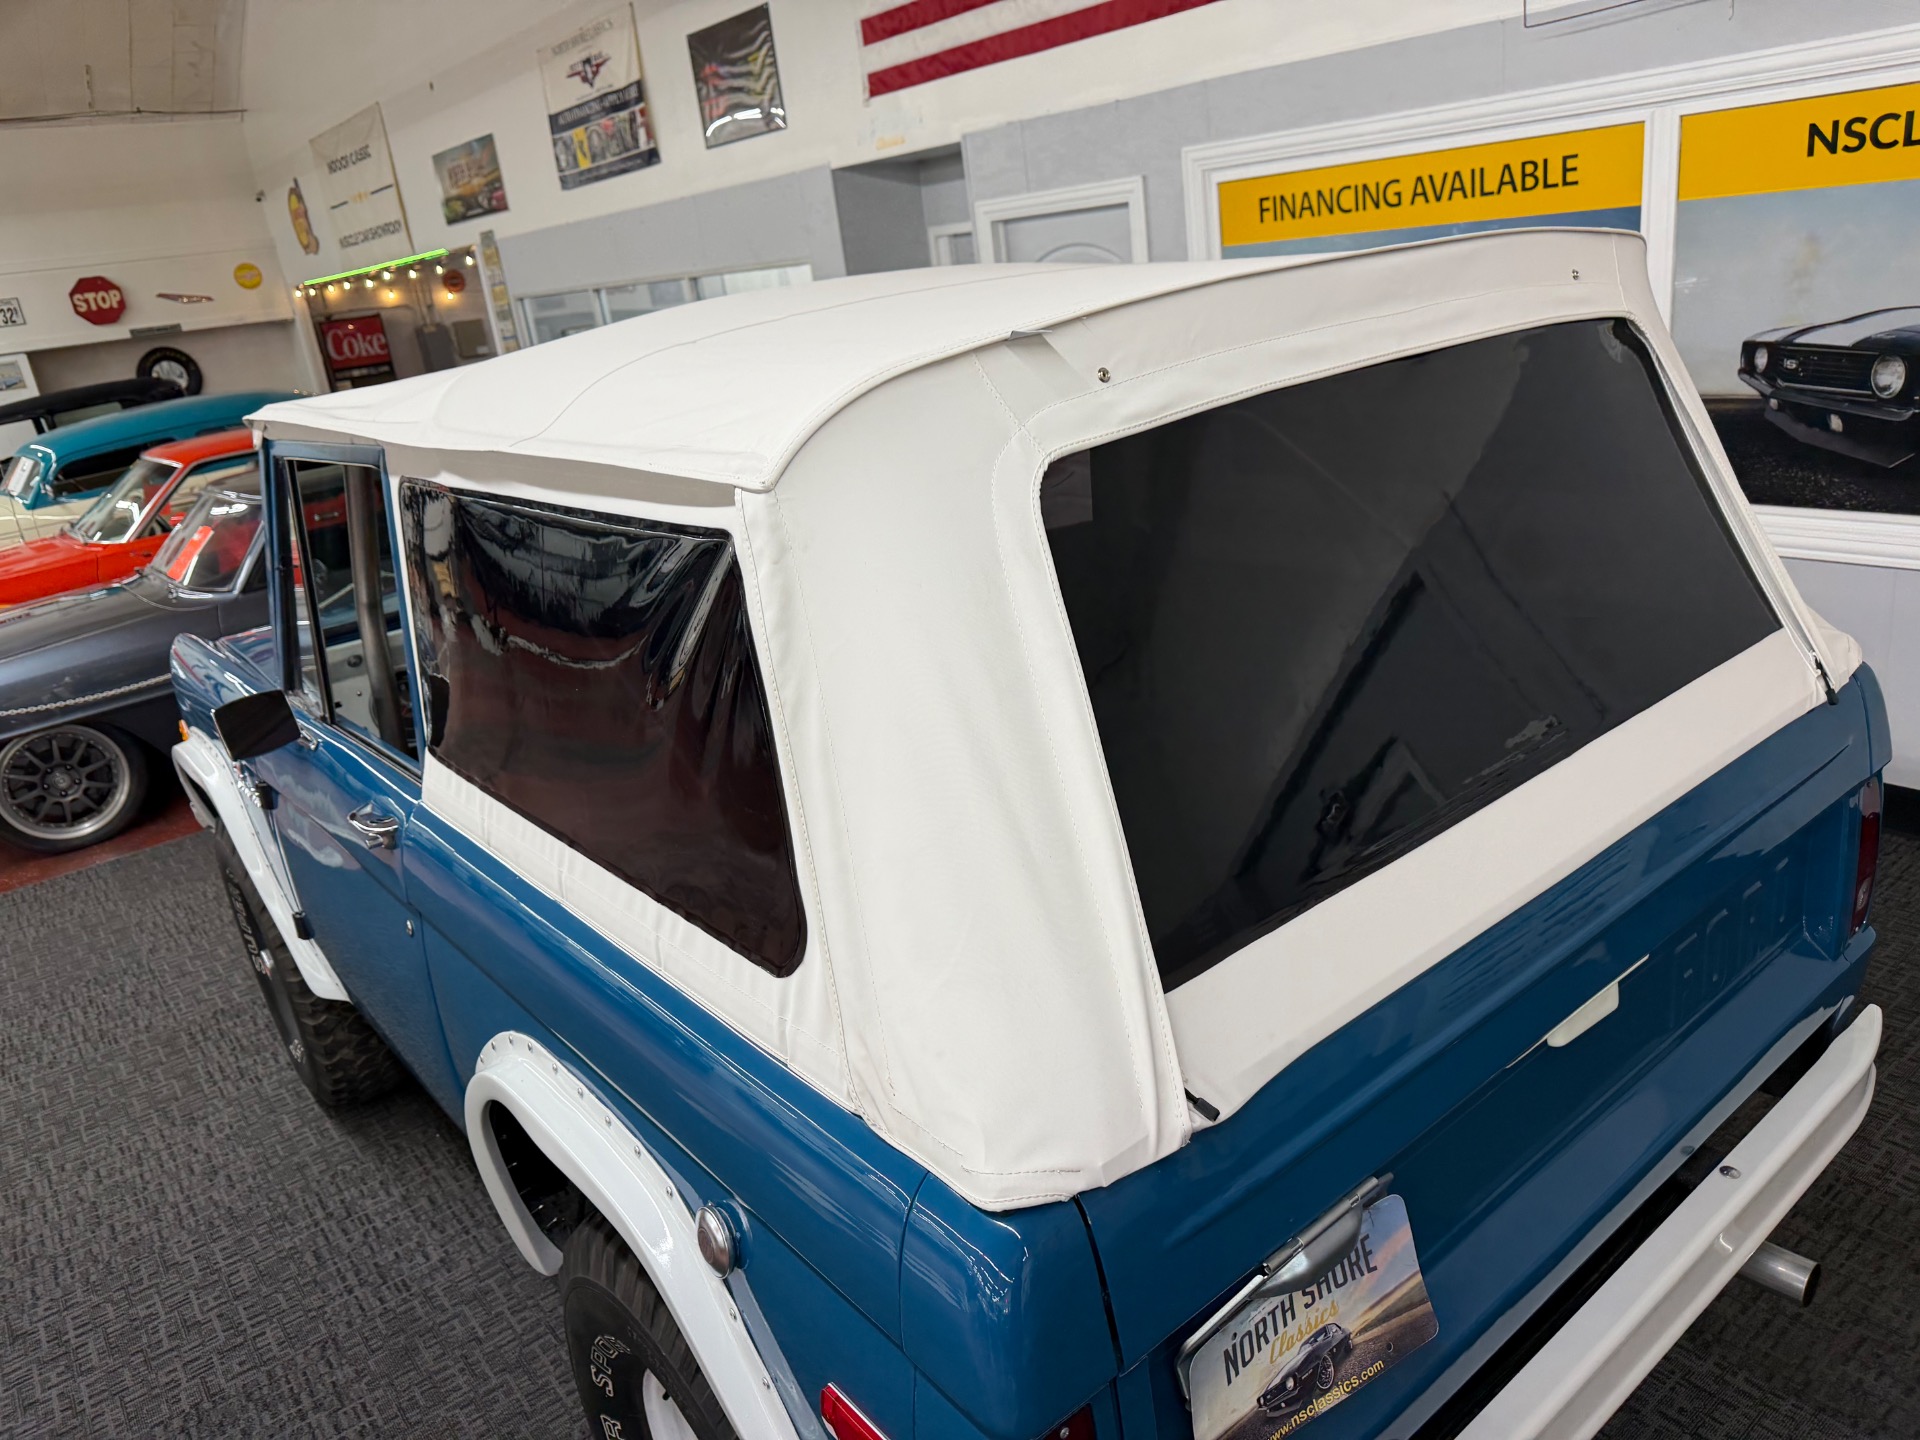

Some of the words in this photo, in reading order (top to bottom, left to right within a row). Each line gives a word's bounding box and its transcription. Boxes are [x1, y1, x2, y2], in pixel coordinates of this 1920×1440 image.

[1806, 109, 1920, 158] NSCL
[1259, 178, 1403, 224] FINANCING
[1410, 153, 1579, 206] AVAILABLE
[72, 289, 121, 313] STOP
[326, 328, 389, 361] Coke
[1223, 1293, 1296, 1387] NORTH
[1301, 1233, 1378, 1310] SHORE
[1269, 1299, 1339, 1365] Classics
[1267, 1359, 1385, 1440] ww.nsclassics.com
